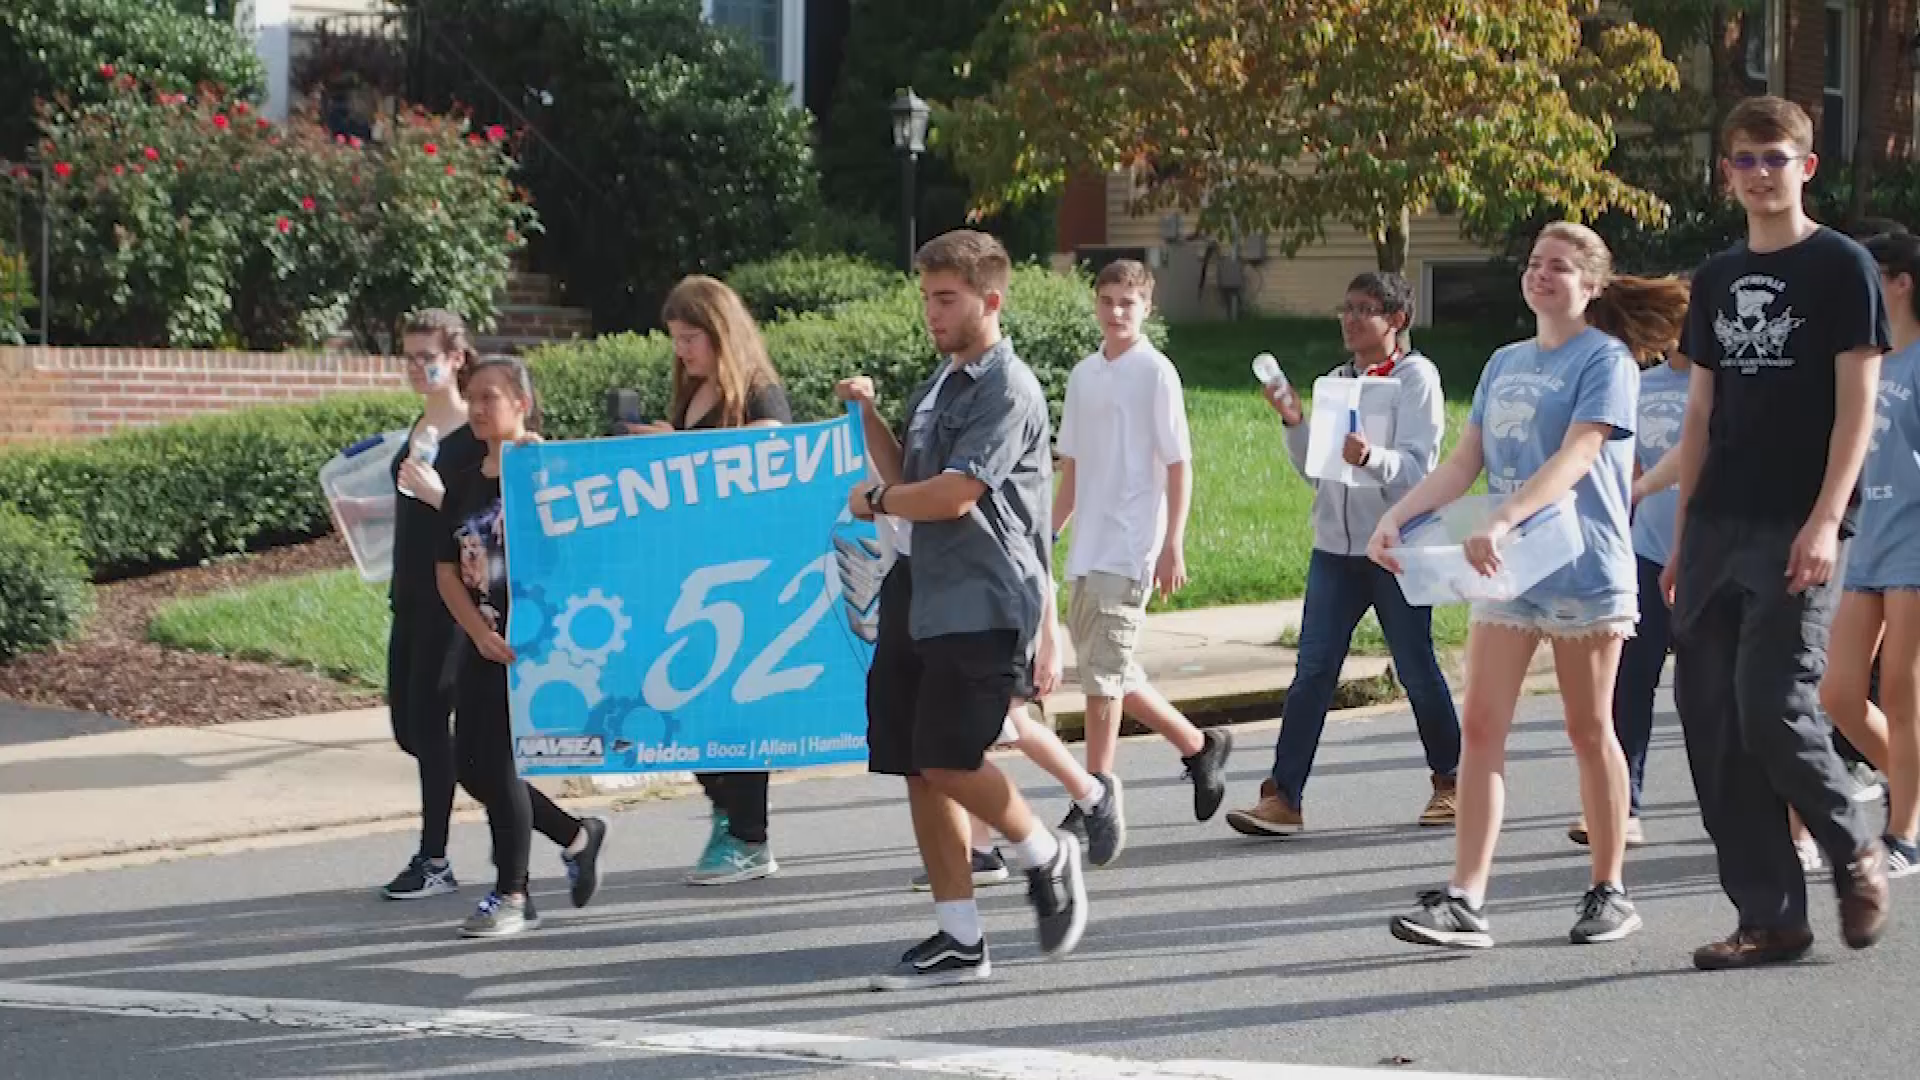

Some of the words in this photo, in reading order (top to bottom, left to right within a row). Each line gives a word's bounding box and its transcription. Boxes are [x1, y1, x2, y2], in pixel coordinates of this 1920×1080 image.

[517, 738, 603, 756] NAVSEA
[638, 741, 700, 763] leidos
[706, 740, 746, 758] Booz
[758, 737, 798, 755] Allen
